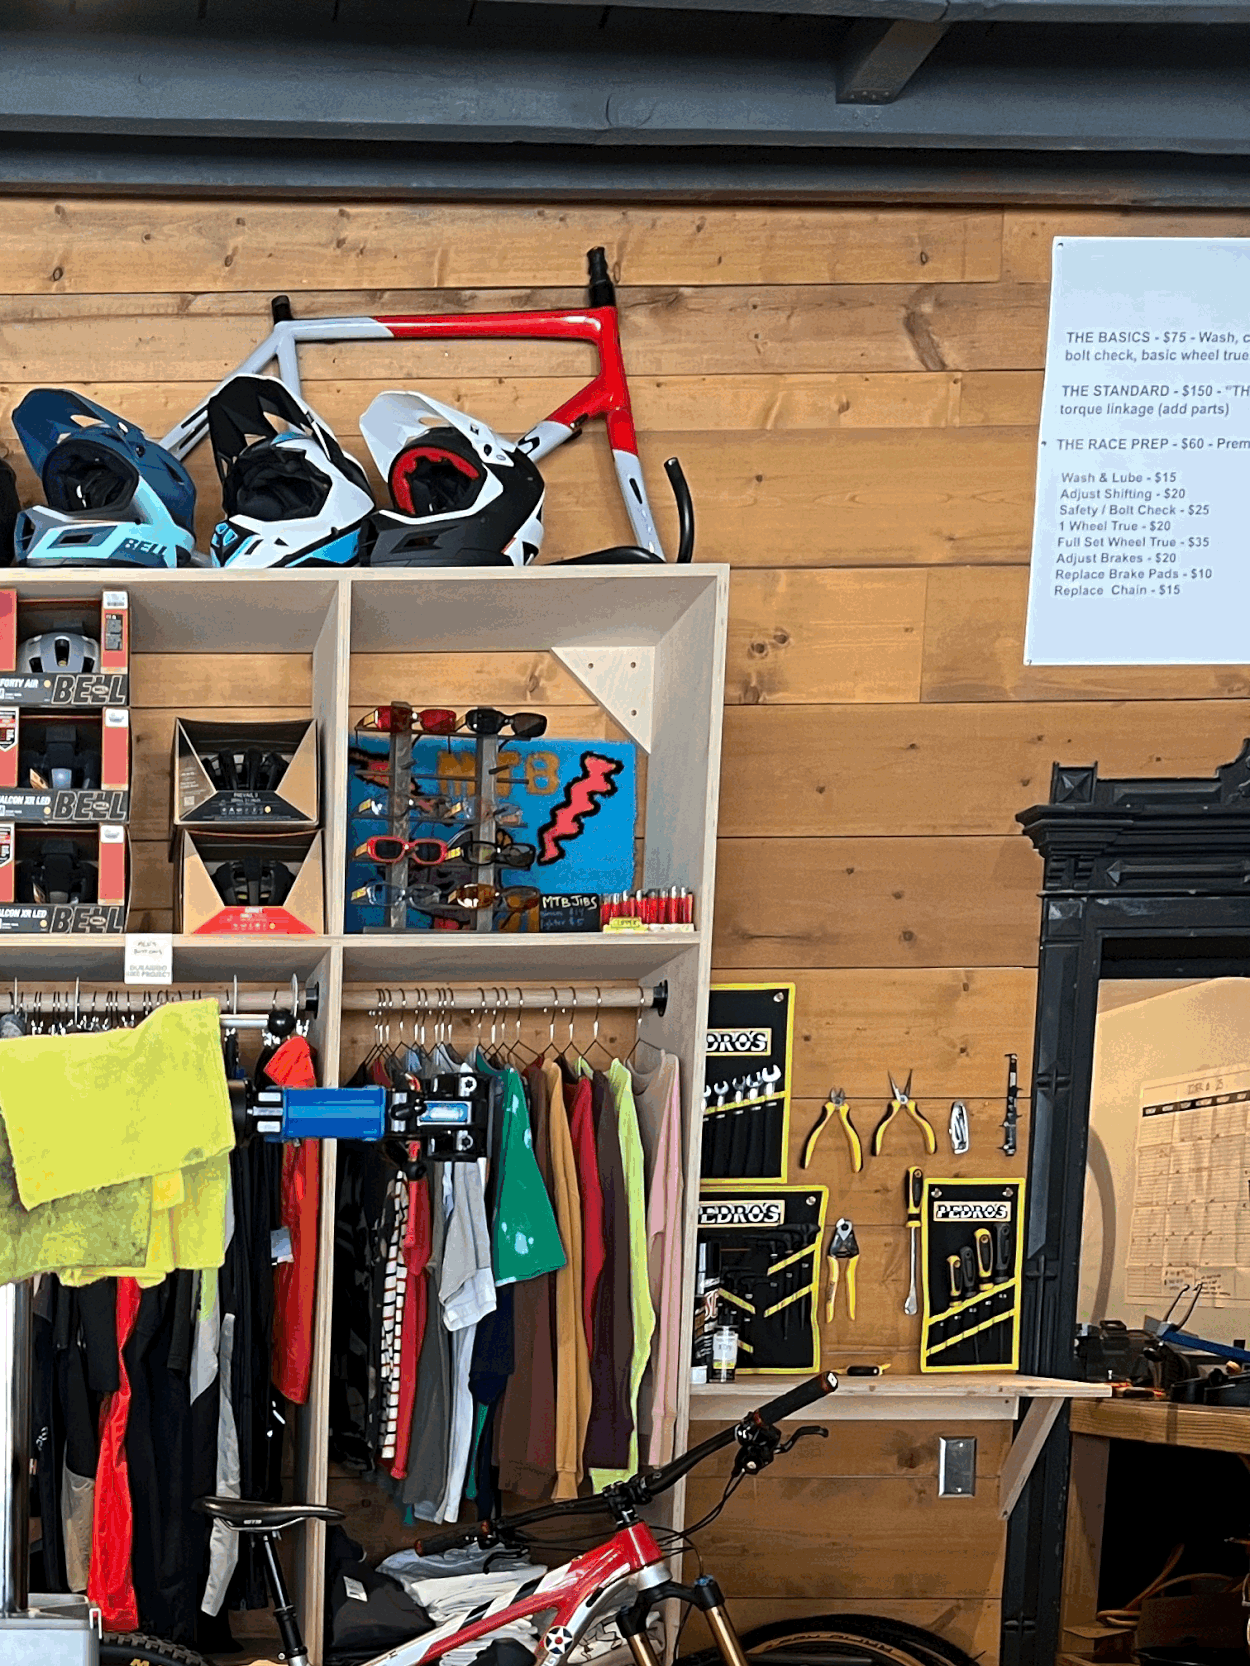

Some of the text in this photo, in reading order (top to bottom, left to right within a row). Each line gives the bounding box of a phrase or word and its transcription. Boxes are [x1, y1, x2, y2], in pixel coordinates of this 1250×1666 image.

[1067, 332, 1093, 343] THE
[1099, 332, 1149, 342] BASICS
[1163, 332, 1186, 343] $75
[1199, 332, 1238, 344] Wash,
[1066, 350, 1248, 361] bolt check, basic wheel true
[1062, 385, 1088, 396] THE
[1094, 385, 1169, 396] STANDARD
[1182, 385, 1212, 397] $150
[1061, 403, 1229, 417] torque linkage (add parts)
[1057, 439, 1083, 450] THE
[1089, 439, 1126, 449] RACE
[1131, 439, 1168, 449] PREP
[1182, 438, 1204, 449] $60
[1062, 472, 1176, 483] Wash & Lube $15
[1061, 488, 1185, 501] Adjust Shifting $20
[1060, 505, 1209, 517] Safety Bolt Check $25
[1060, 521, 1170, 531] 1 Wheel True $20
[1058, 537, 1209, 547] Full Set Wheel True $35
[1056, 553, 1176, 565] Adjust Brakes $20
[1056, 569, 1212, 581] Replace Brake Pads $10
[1055, 585, 1180, 597] Replace Chain $15
[24, 679, 39, 689] AIR
[698, 1202, 781, 1224] EDRO'S
